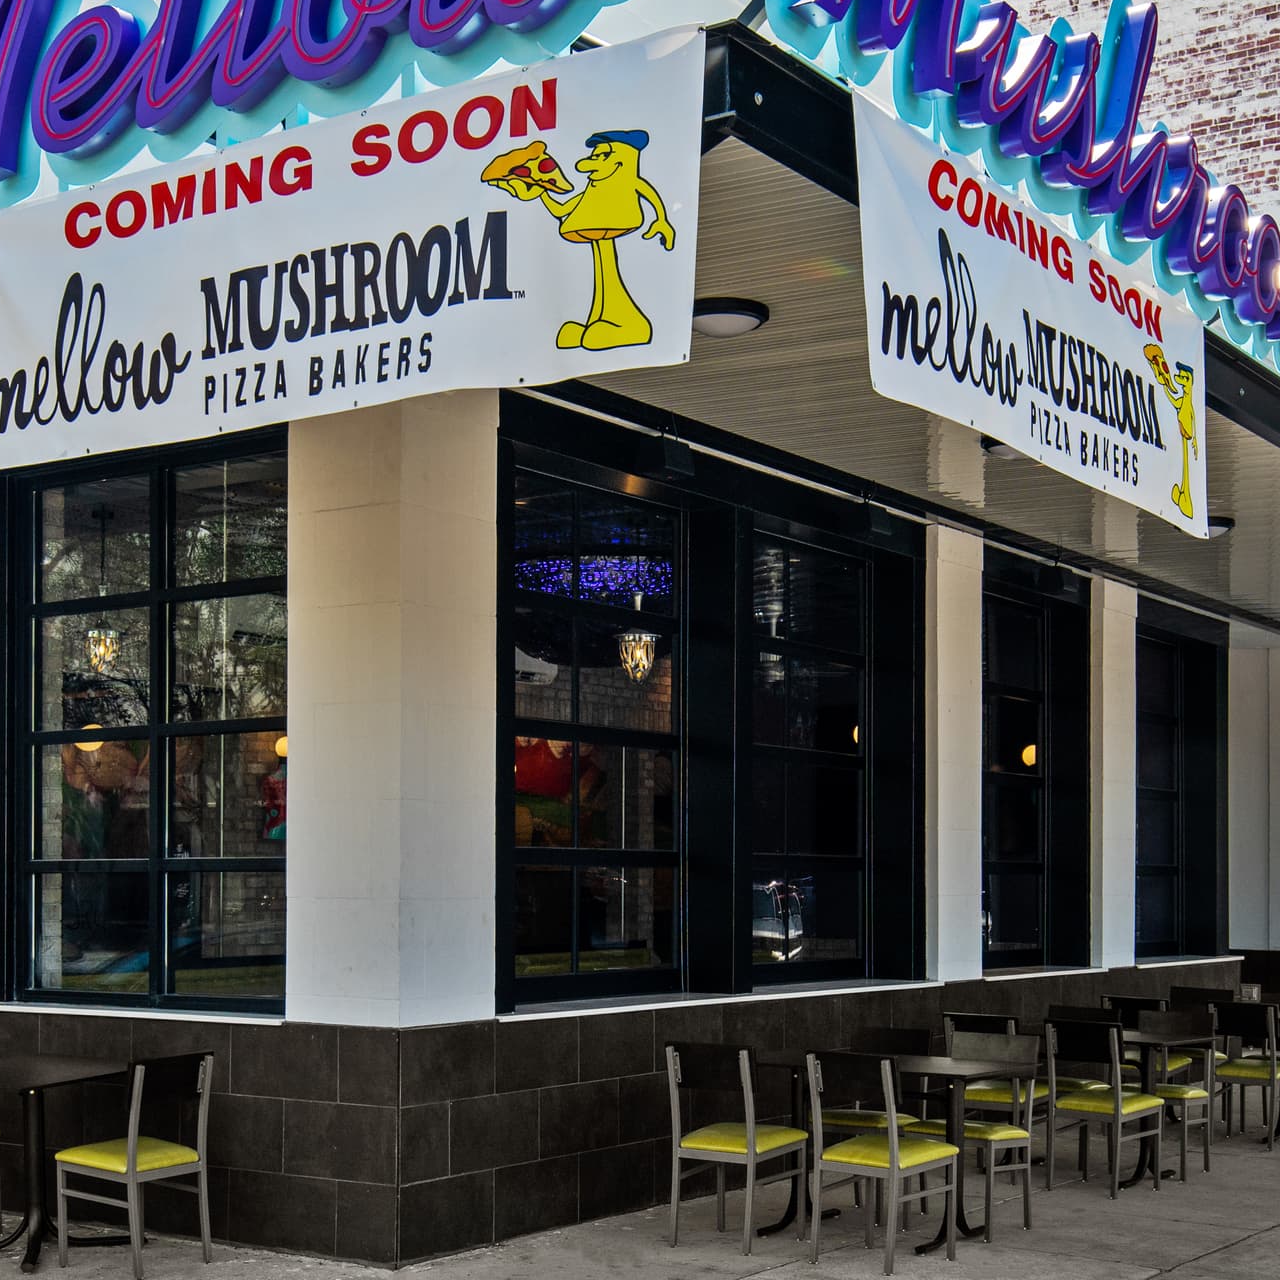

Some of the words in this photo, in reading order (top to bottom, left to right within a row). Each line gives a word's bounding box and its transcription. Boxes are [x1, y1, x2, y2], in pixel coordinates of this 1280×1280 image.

[64, 145, 313, 249] COMING
[350, 77, 559, 176] SOON
[200, 211, 512, 361] MUSHROOM
[927, 160, 1074, 284] COMING
[1089, 260, 1163, 342] SOON
[205, 357, 286, 415] PIZZA
[309, 332, 433, 396] BAKERS
[882, 228, 1024, 408] mellow
[1023, 309, 1163, 450] MUSHROOM
[1030, 400, 1071, 456] PIZZA
[1079, 430, 1140, 486] BAKERS
